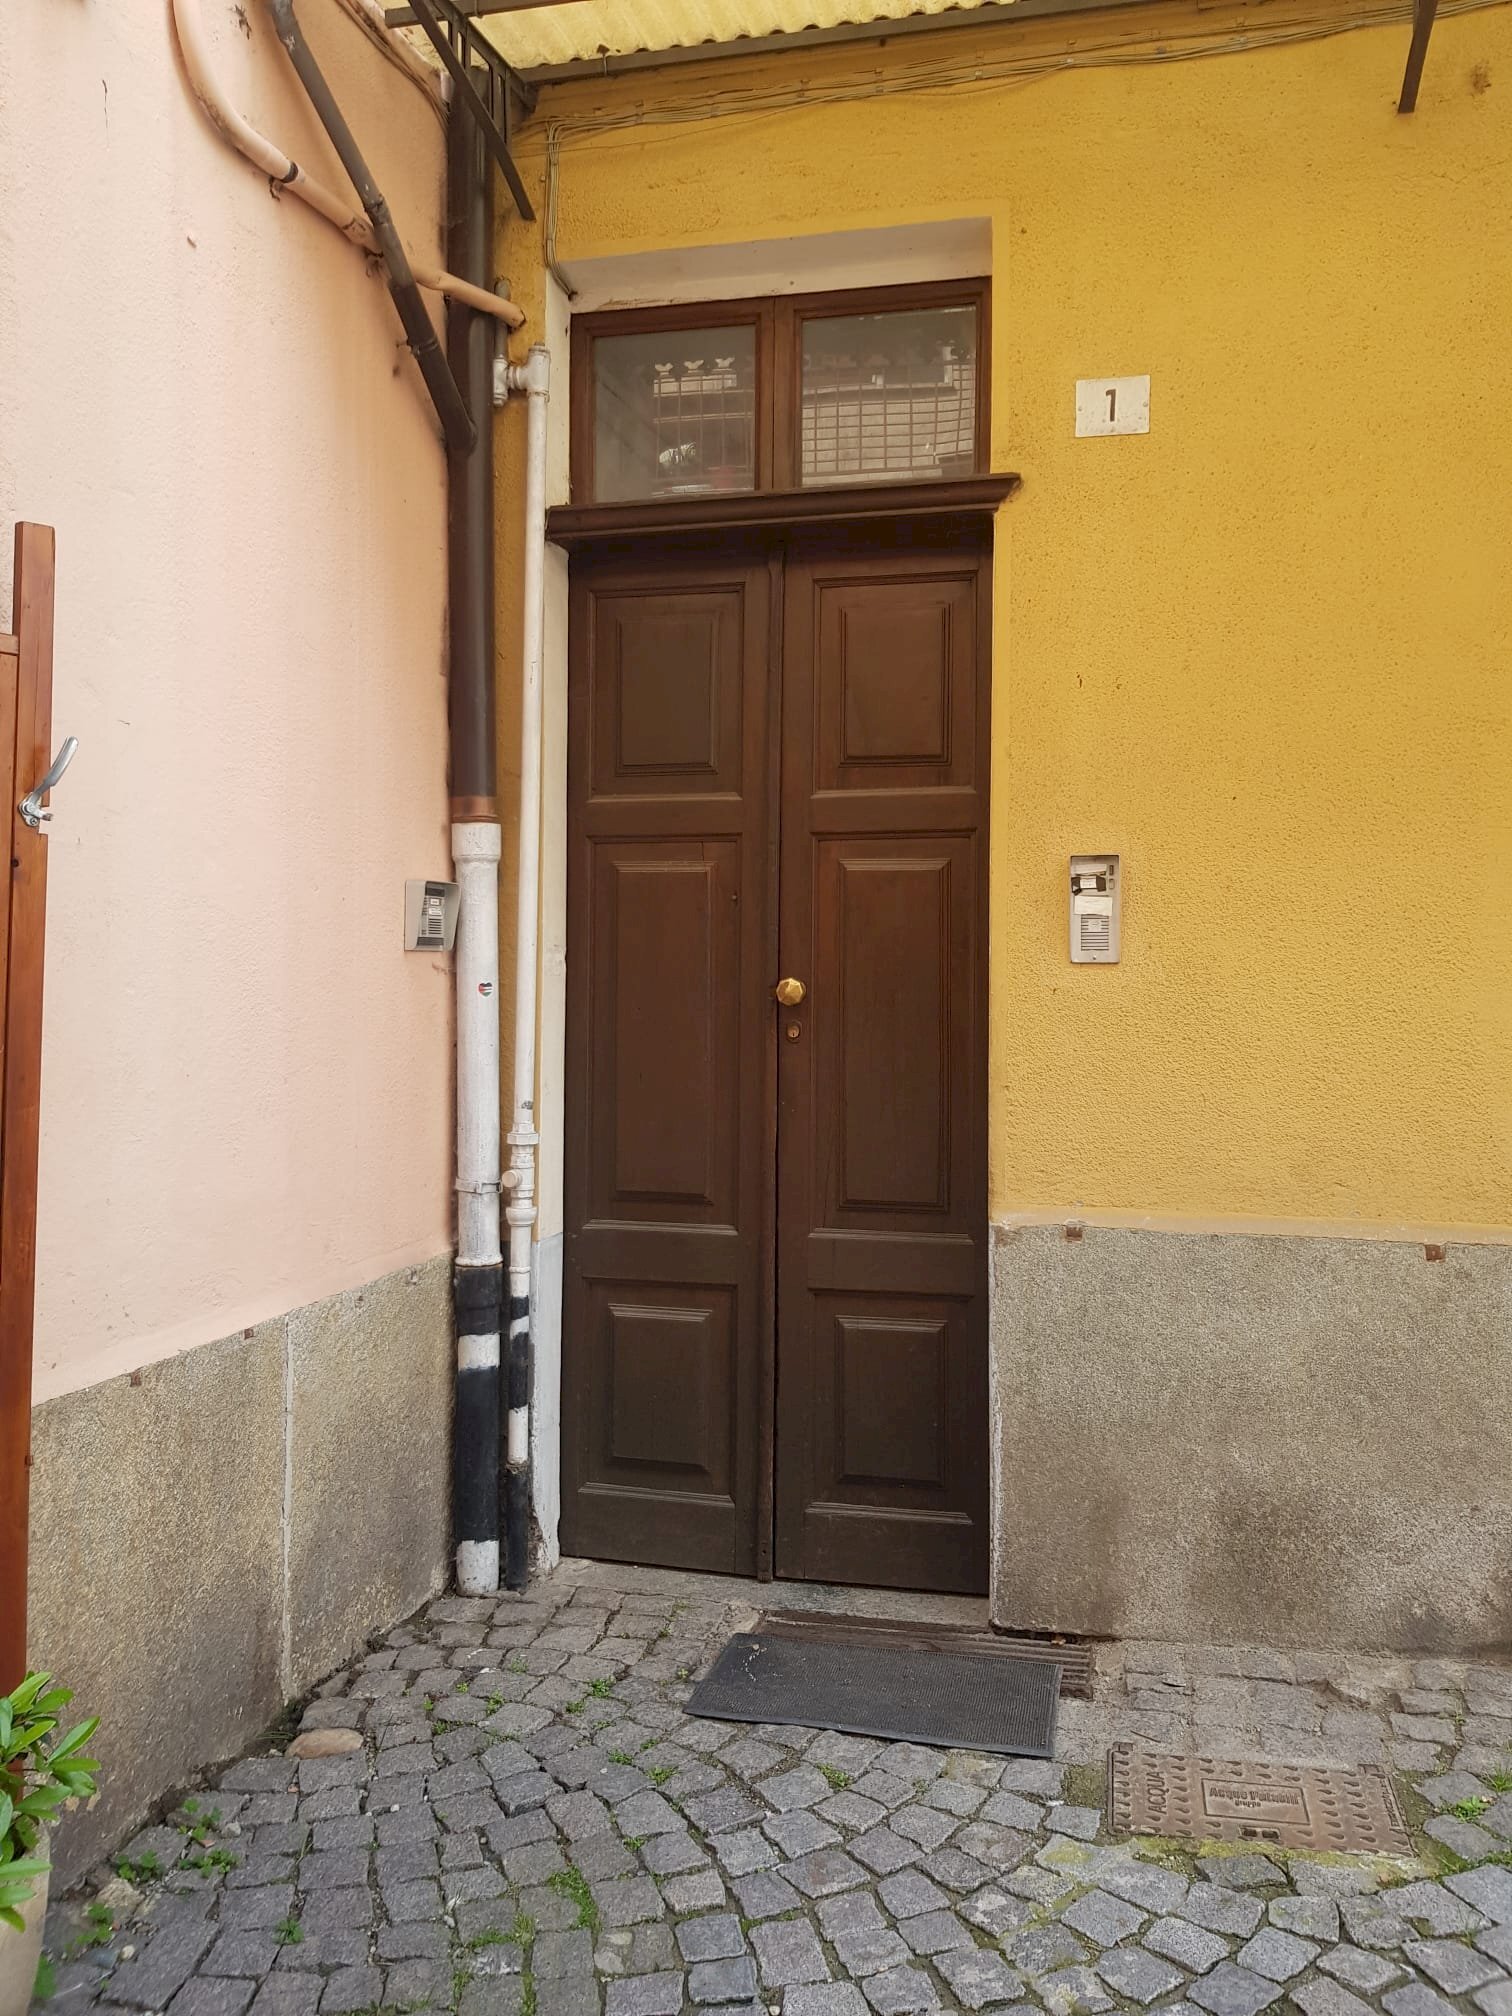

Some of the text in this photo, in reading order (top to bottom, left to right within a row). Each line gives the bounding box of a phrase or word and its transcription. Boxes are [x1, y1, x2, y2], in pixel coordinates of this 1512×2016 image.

[1105, 388, 1117, 422] 1
[1146, 1771, 1169, 1815] ACQUA
[1210, 1787, 1248, 1802] Acque
